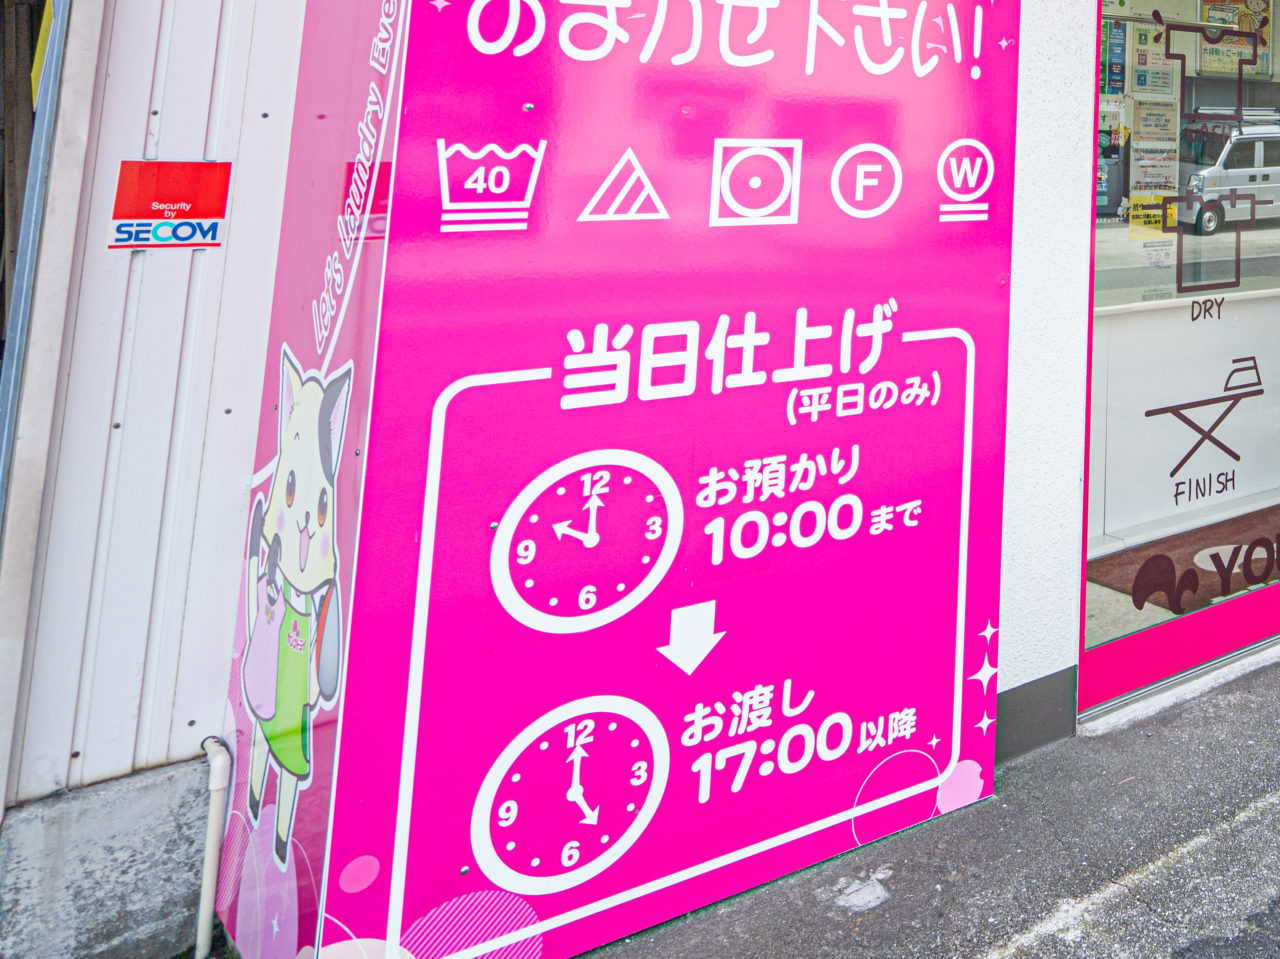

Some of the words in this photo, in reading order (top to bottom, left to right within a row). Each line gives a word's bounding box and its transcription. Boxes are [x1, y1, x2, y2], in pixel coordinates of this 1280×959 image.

[338, 80, 385, 262] Laundry
[464, 166, 510, 195] 40
[151, 202, 192, 211] Security
[164, 210, 176, 219] by
[114, 221, 219, 243] SECOM
[1191, 297, 1224, 321] DRY
[560, 298, 898, 410] 当日仕上げ
[786, 371, 941, 426] (平日のみ)
[580, 471, 610, 497] 12
[695, 444, 860, 509] お預かり
[1174, 470, 1236, 505] FINISH
[645, 516, 662, 539] 3
[704, 494, 862, 566] 10:00
[869, 499, 923, 536] まで
[516, 539, 536, 565] 9
[578, 585, 597, 610] 6
[681, 678, 816, 748] お渡し
[564, 719, 595, 749] 12
[691, 712, 852, 803] 17:00
[856, 707, 918, 754] 以降
[630, 761, 648, 786] 3
[498, 800, 518, 827] 9
[561, 841, 580, 867] 6
